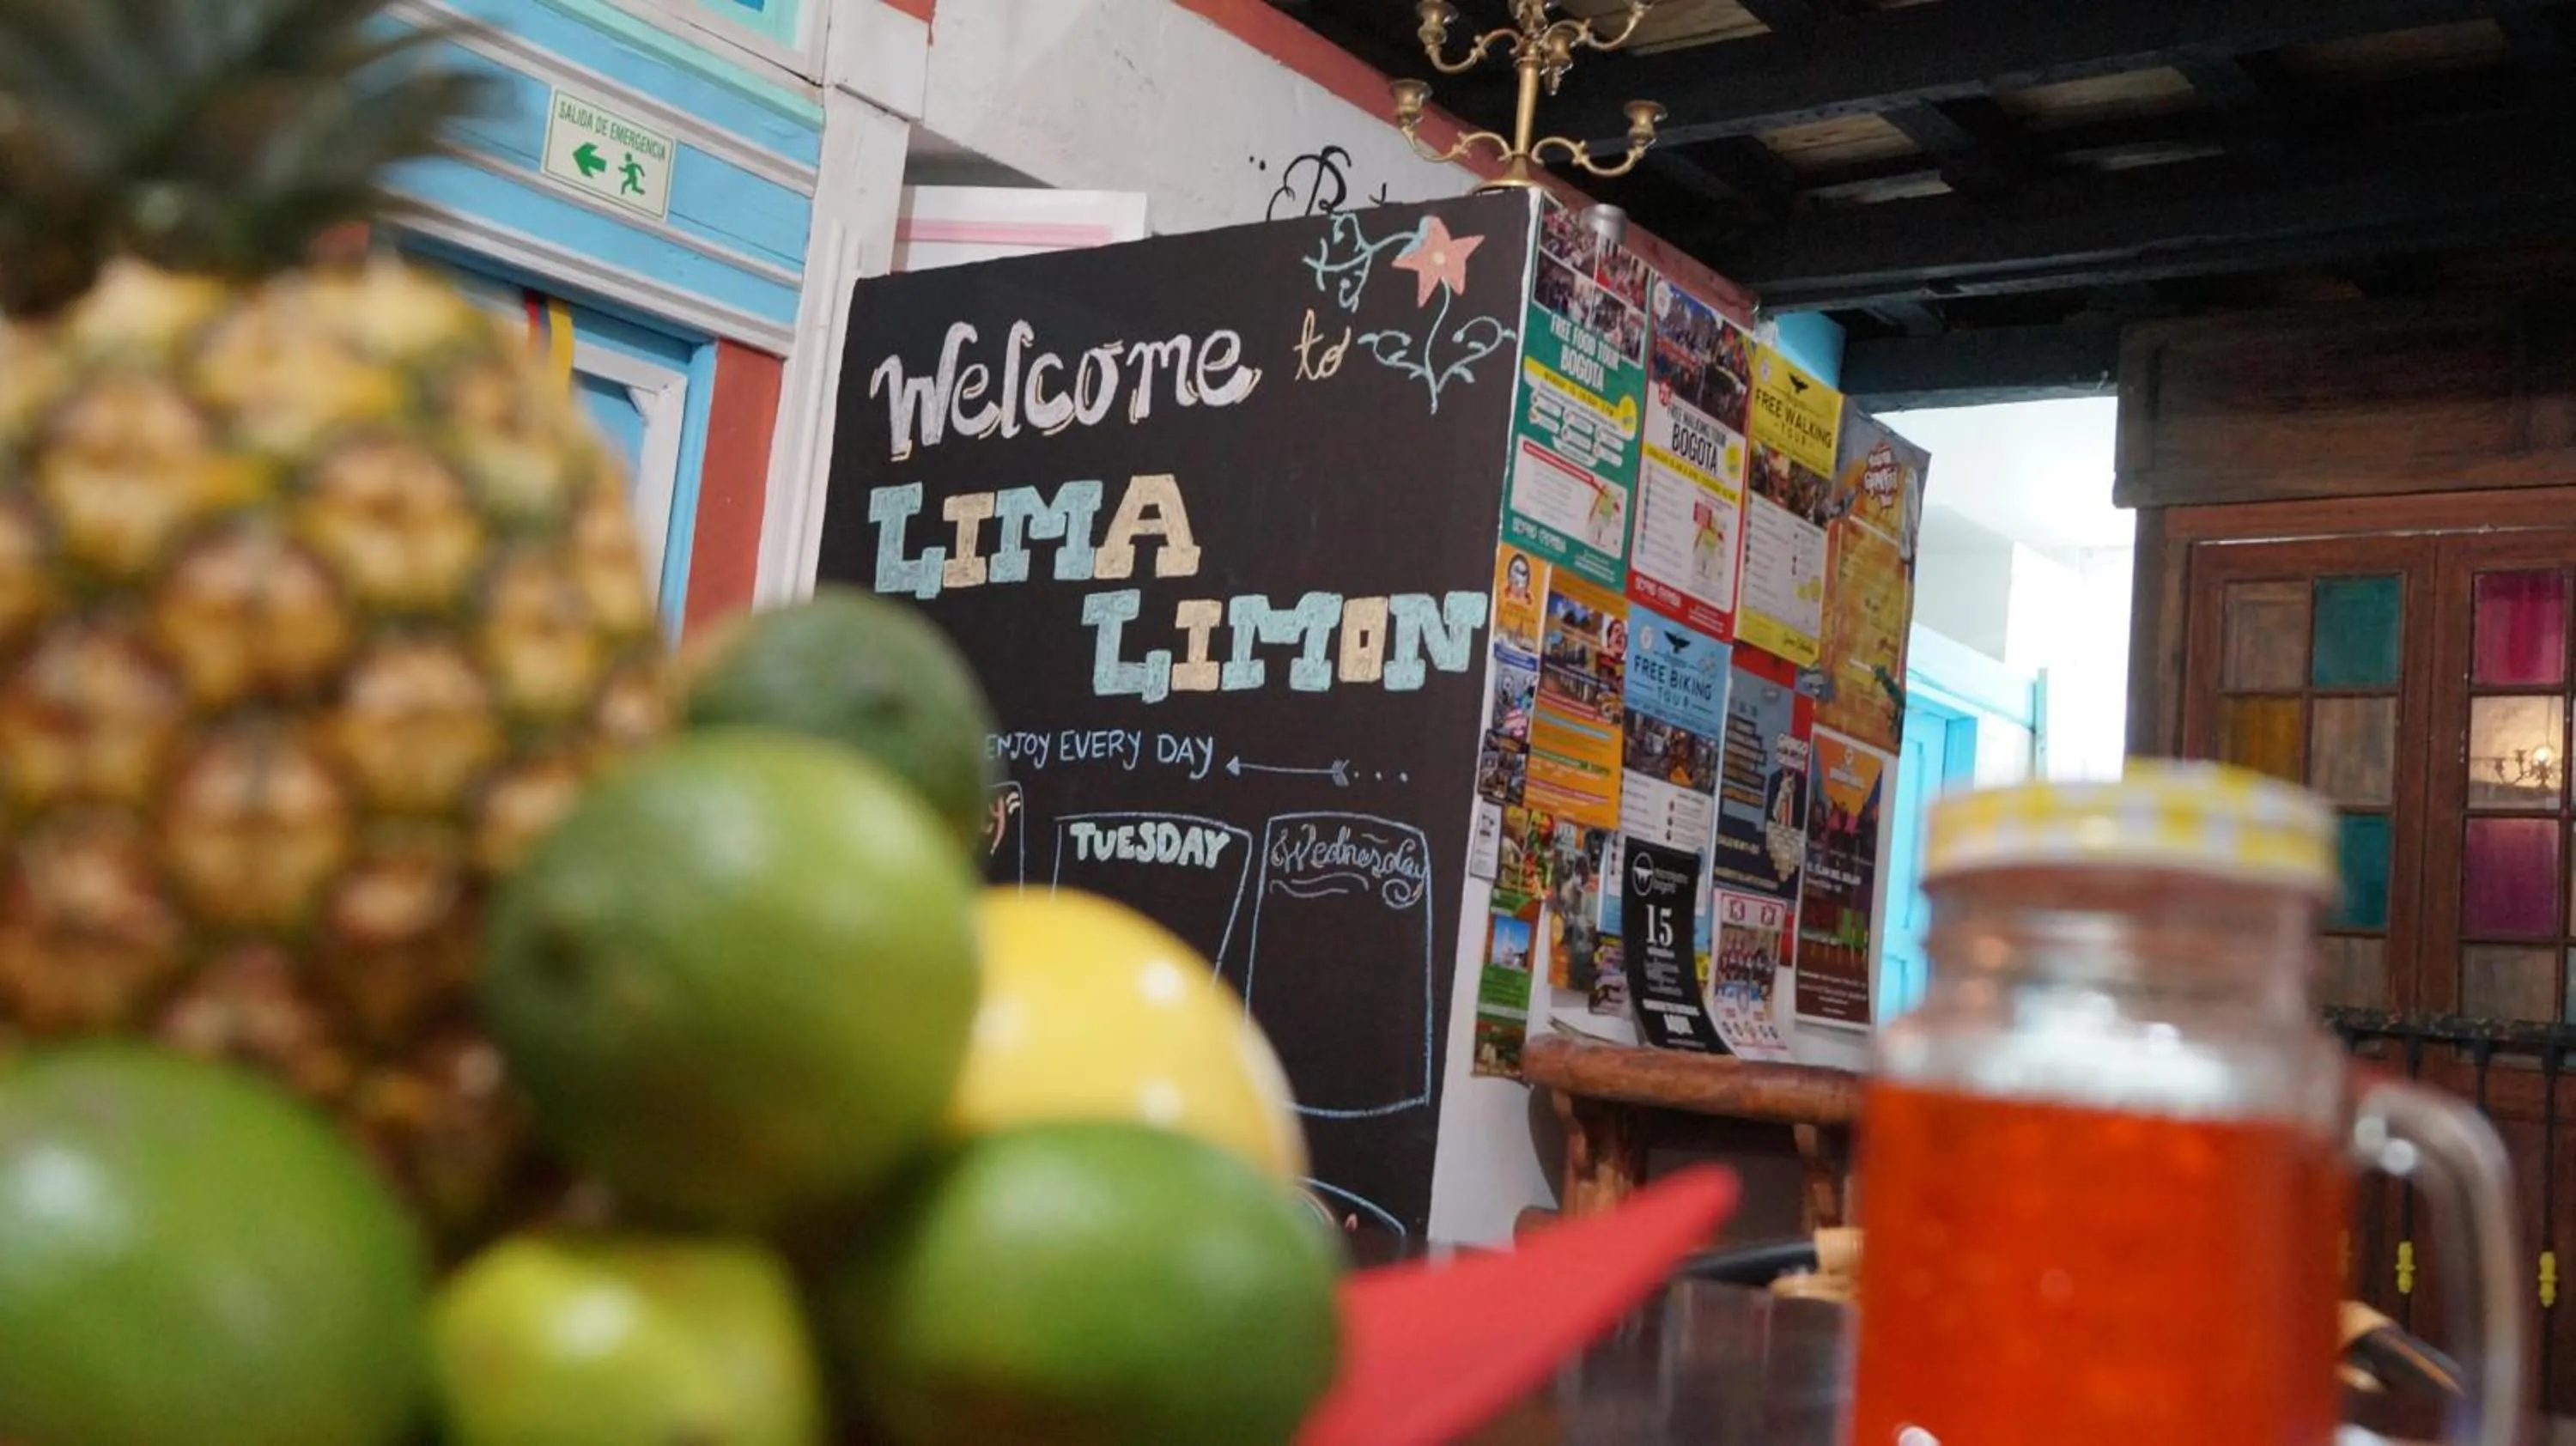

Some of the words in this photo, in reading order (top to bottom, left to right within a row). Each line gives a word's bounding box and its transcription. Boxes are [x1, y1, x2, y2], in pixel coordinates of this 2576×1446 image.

[559, 100, 592, 130] SALIDA
[595, 115, 608, 137] DE
[610, 122, 665, 161] EMERGENCIA
[870, 319, 1261, 462] Welcome
[1295, 309, 1351, 382] to
[1560, 343, 1605, 393] BOGOTA
[1756, 386, 1783, 419] FREE
[1785, 406, 1832, 449] WALKING
[1672, 423, 1717, 475] BOGOTA
[868, 474, 1201, 598] LIMA
[1082, 589, 1488, 703] LIMON
[1634, 655, 1666, 684] FREE
[1670, 670, 1712, 702] BIKING
[1060, 730, 1141, 770] EVERY
[1157, 734, 1214, 780] DAY
[1070, 822, 1230, 869] TUESDAY
[1271, 823, 1426, 909] Wednesday
[1646, 904, 1674, 947] 15
